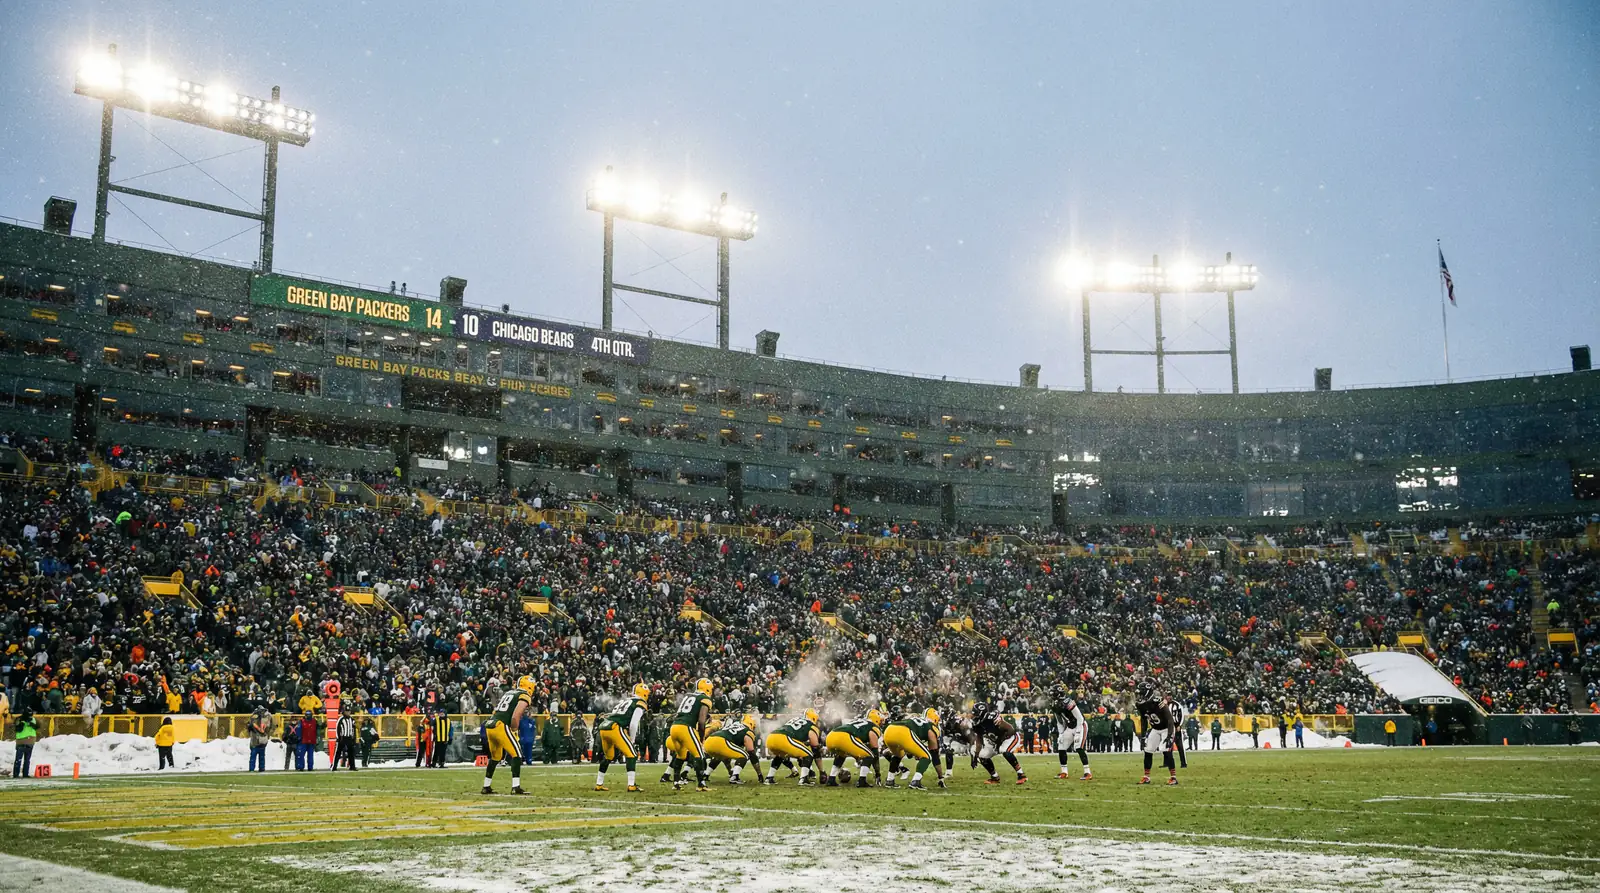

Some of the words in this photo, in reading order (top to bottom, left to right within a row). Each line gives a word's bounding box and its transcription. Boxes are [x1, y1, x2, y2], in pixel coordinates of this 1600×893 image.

[287, 286, 327, 308] GREEN
[330, 293, 354, 312] BAY
[356, 297, 410, 322] PACKERS
[426, 308, 442, 329] 14
[462, 314, 479, 336] 10
[492, 321, 539, 343] CHICAGO
[541, 328, 574, 348] BEARS
[591, 337, 611, 353] 4TH
[612, 341, 635, 358] QTR.
[335, 355, 379, 371] GREEN
[383, 361, 408, 375] BAY
[1419, 697, 1453, 705] GEICO
